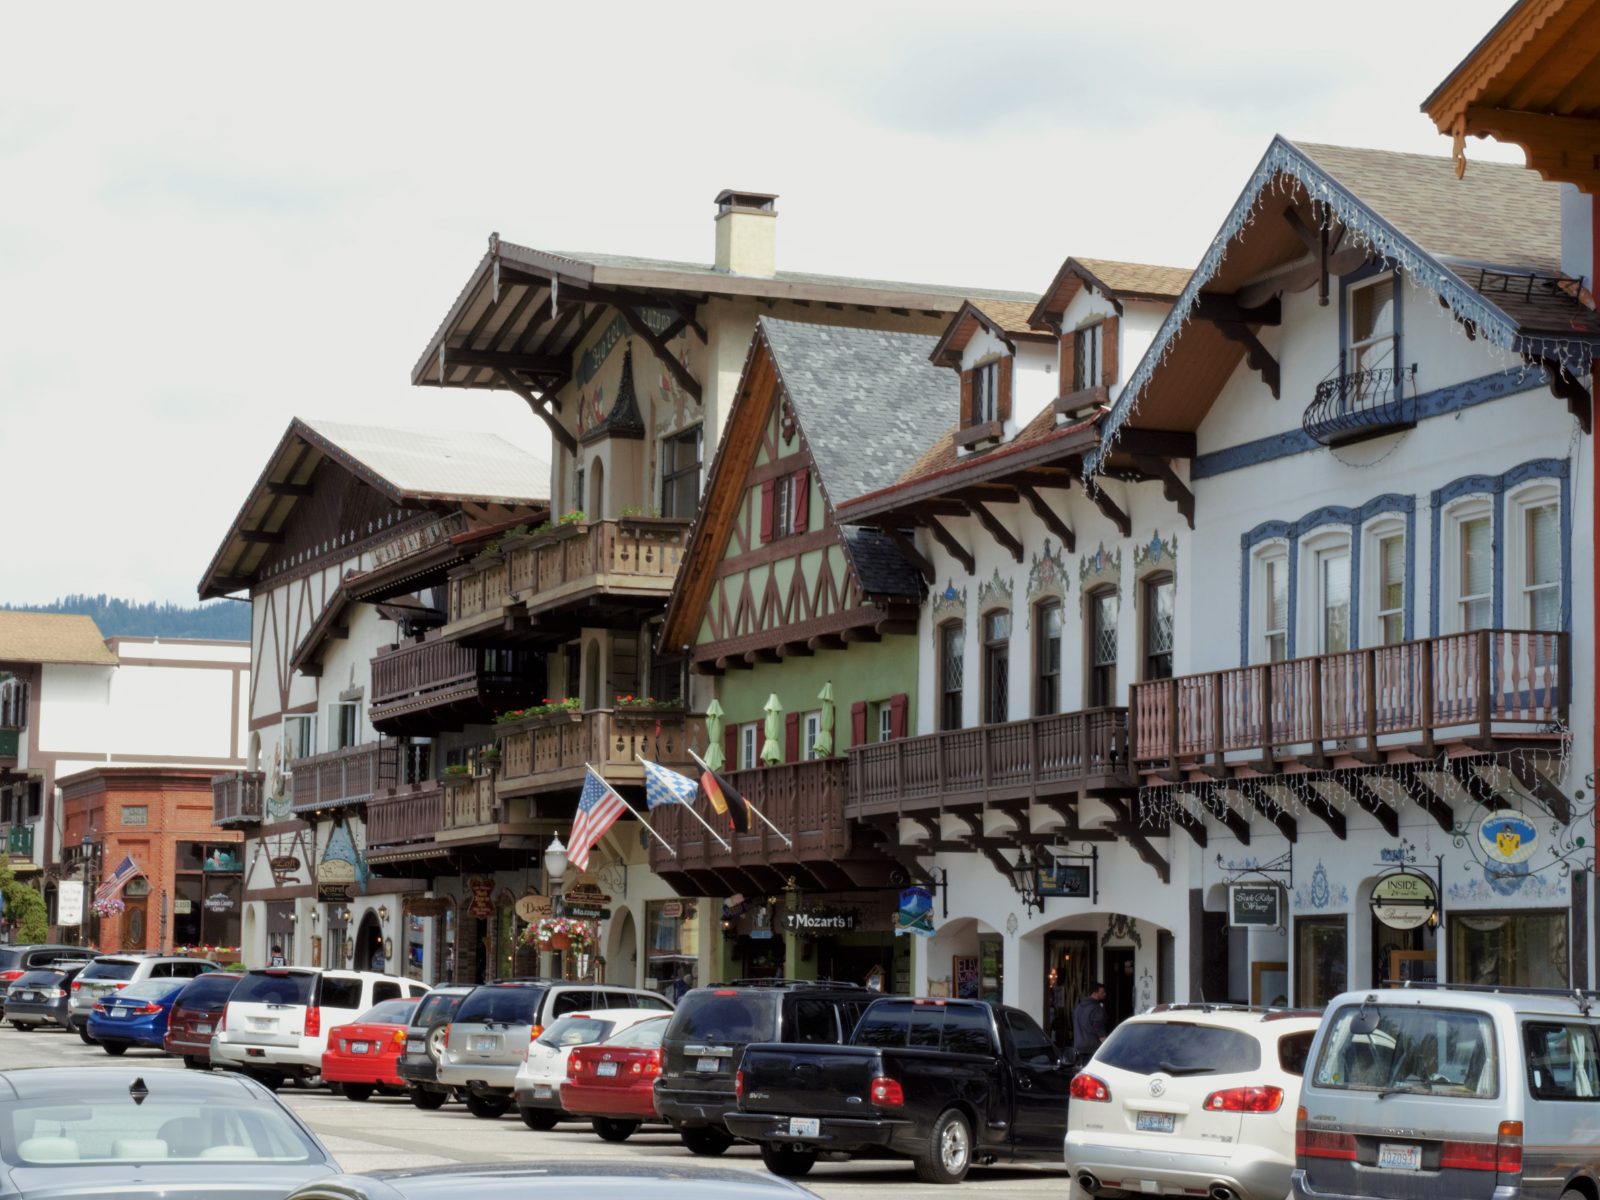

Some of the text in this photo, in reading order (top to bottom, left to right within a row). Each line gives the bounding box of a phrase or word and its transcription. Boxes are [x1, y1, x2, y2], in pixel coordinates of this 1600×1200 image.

[320, 884, 345, 896] Kestrel
[1387, 880, 1418, 890] INSIDE
[573, 907, 601, 918] Massage
[796, 914, 846, 929] Mozart's
